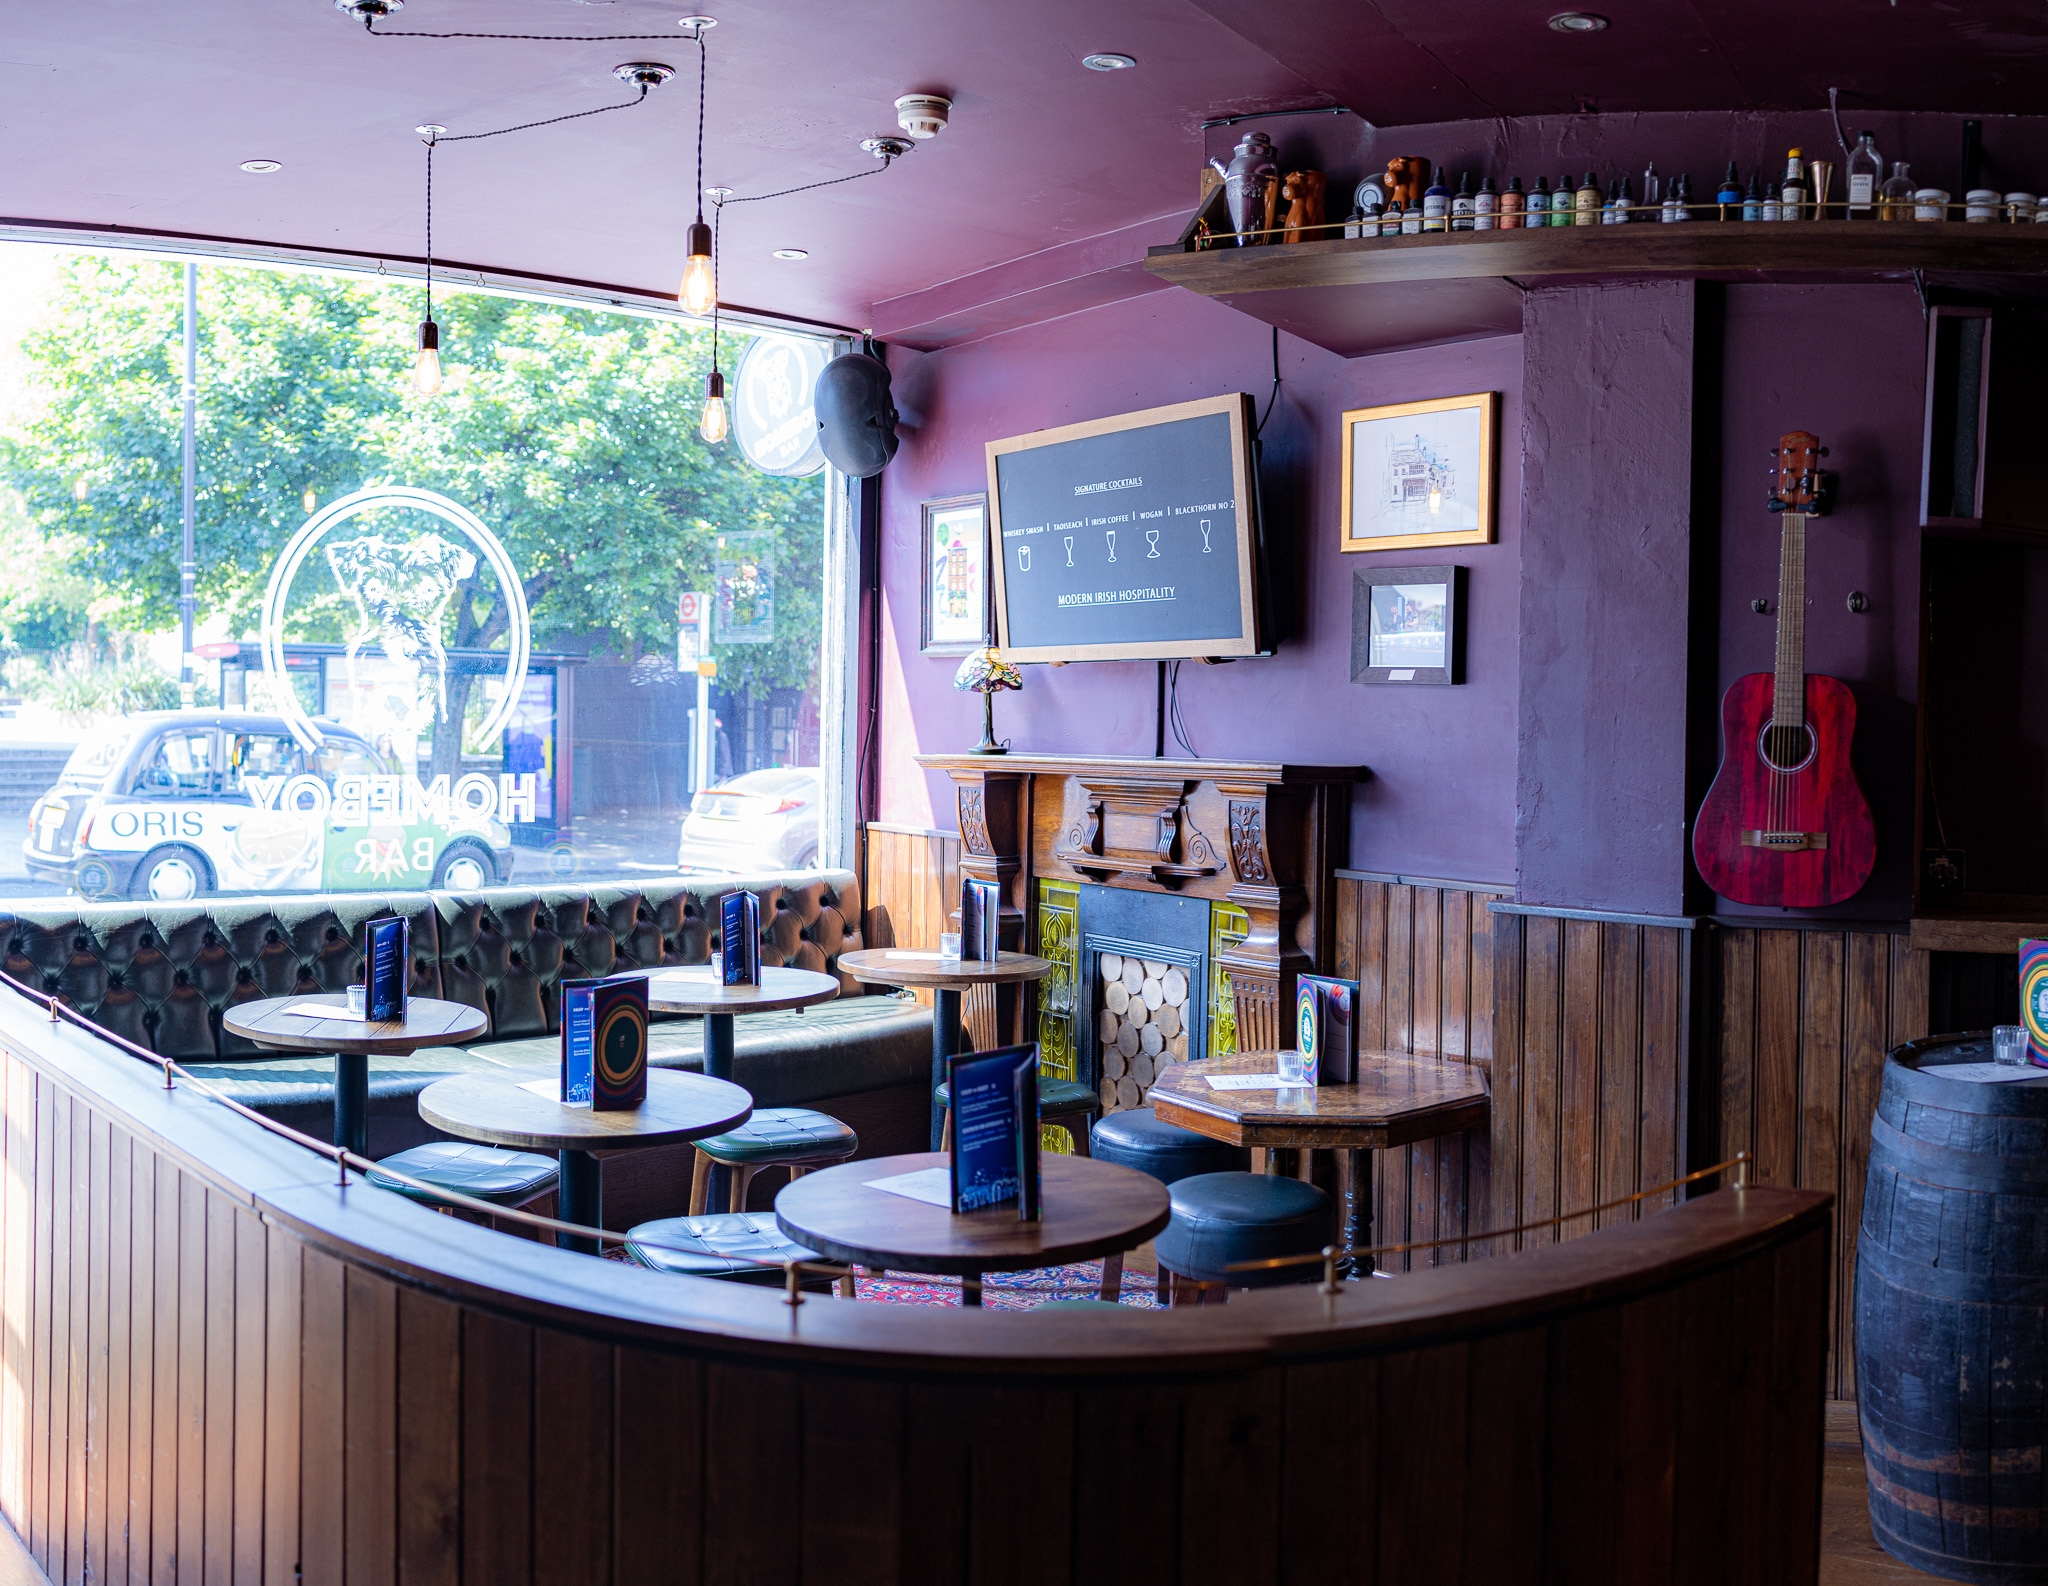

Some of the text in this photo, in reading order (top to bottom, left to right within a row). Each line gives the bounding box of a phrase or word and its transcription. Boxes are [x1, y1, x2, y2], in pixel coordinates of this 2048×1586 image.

[780, 437, 801, 458] BAR
[1074, 477, 1143, 494] SIGNATURE COCKTAILS
[1003, 499, 1235, 538] WHISKEY SMASH TAOISEACH IRISH COFFEE WOGAN BLACKTHORN NO 2
[1058, 586, 1176, 605] MODERN IRISH HOSPITALITY
[111, 811, 203, 837] ORIS
